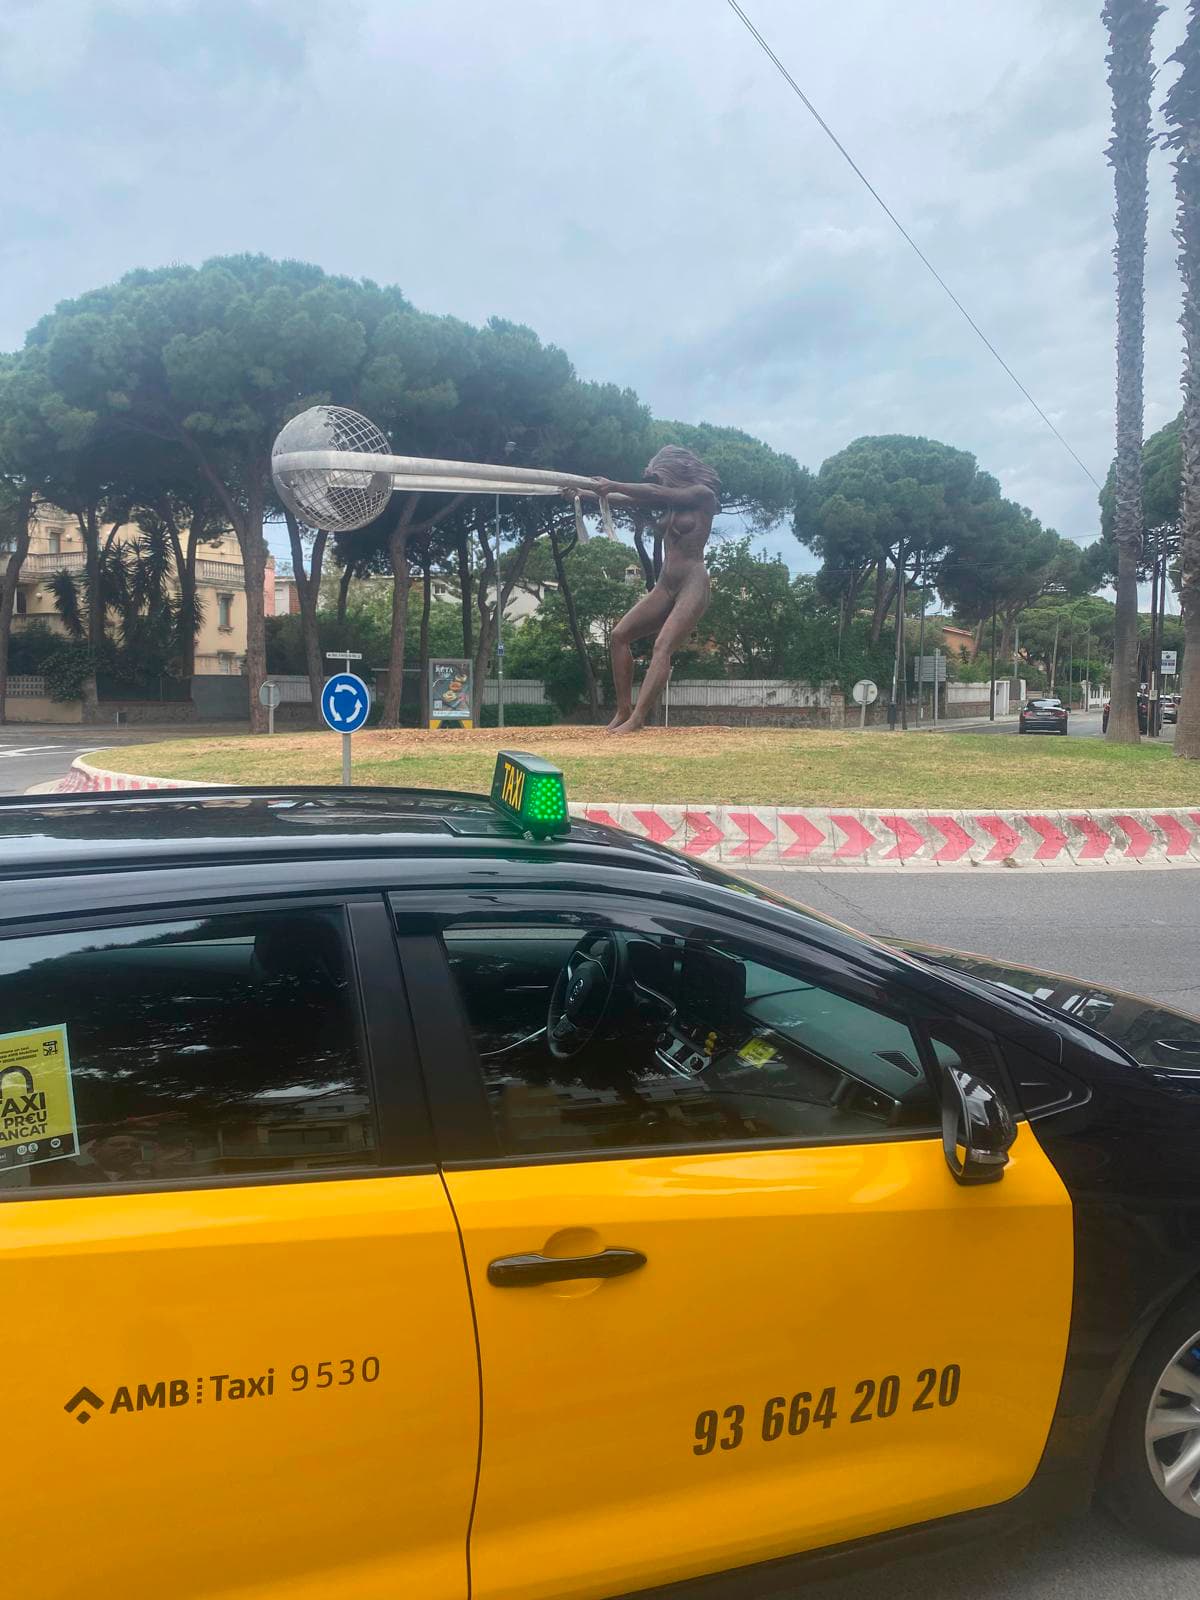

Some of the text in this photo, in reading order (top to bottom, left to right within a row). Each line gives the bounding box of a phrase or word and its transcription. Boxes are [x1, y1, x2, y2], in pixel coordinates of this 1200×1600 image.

[502, 762, 525, 811] TAXI
[0, 1092, 46, 1117] AXI
[110, 1356, 380, 1414] AMB Taxi 9530
[693, 1363, 961, 1456] 93 664 20 20
